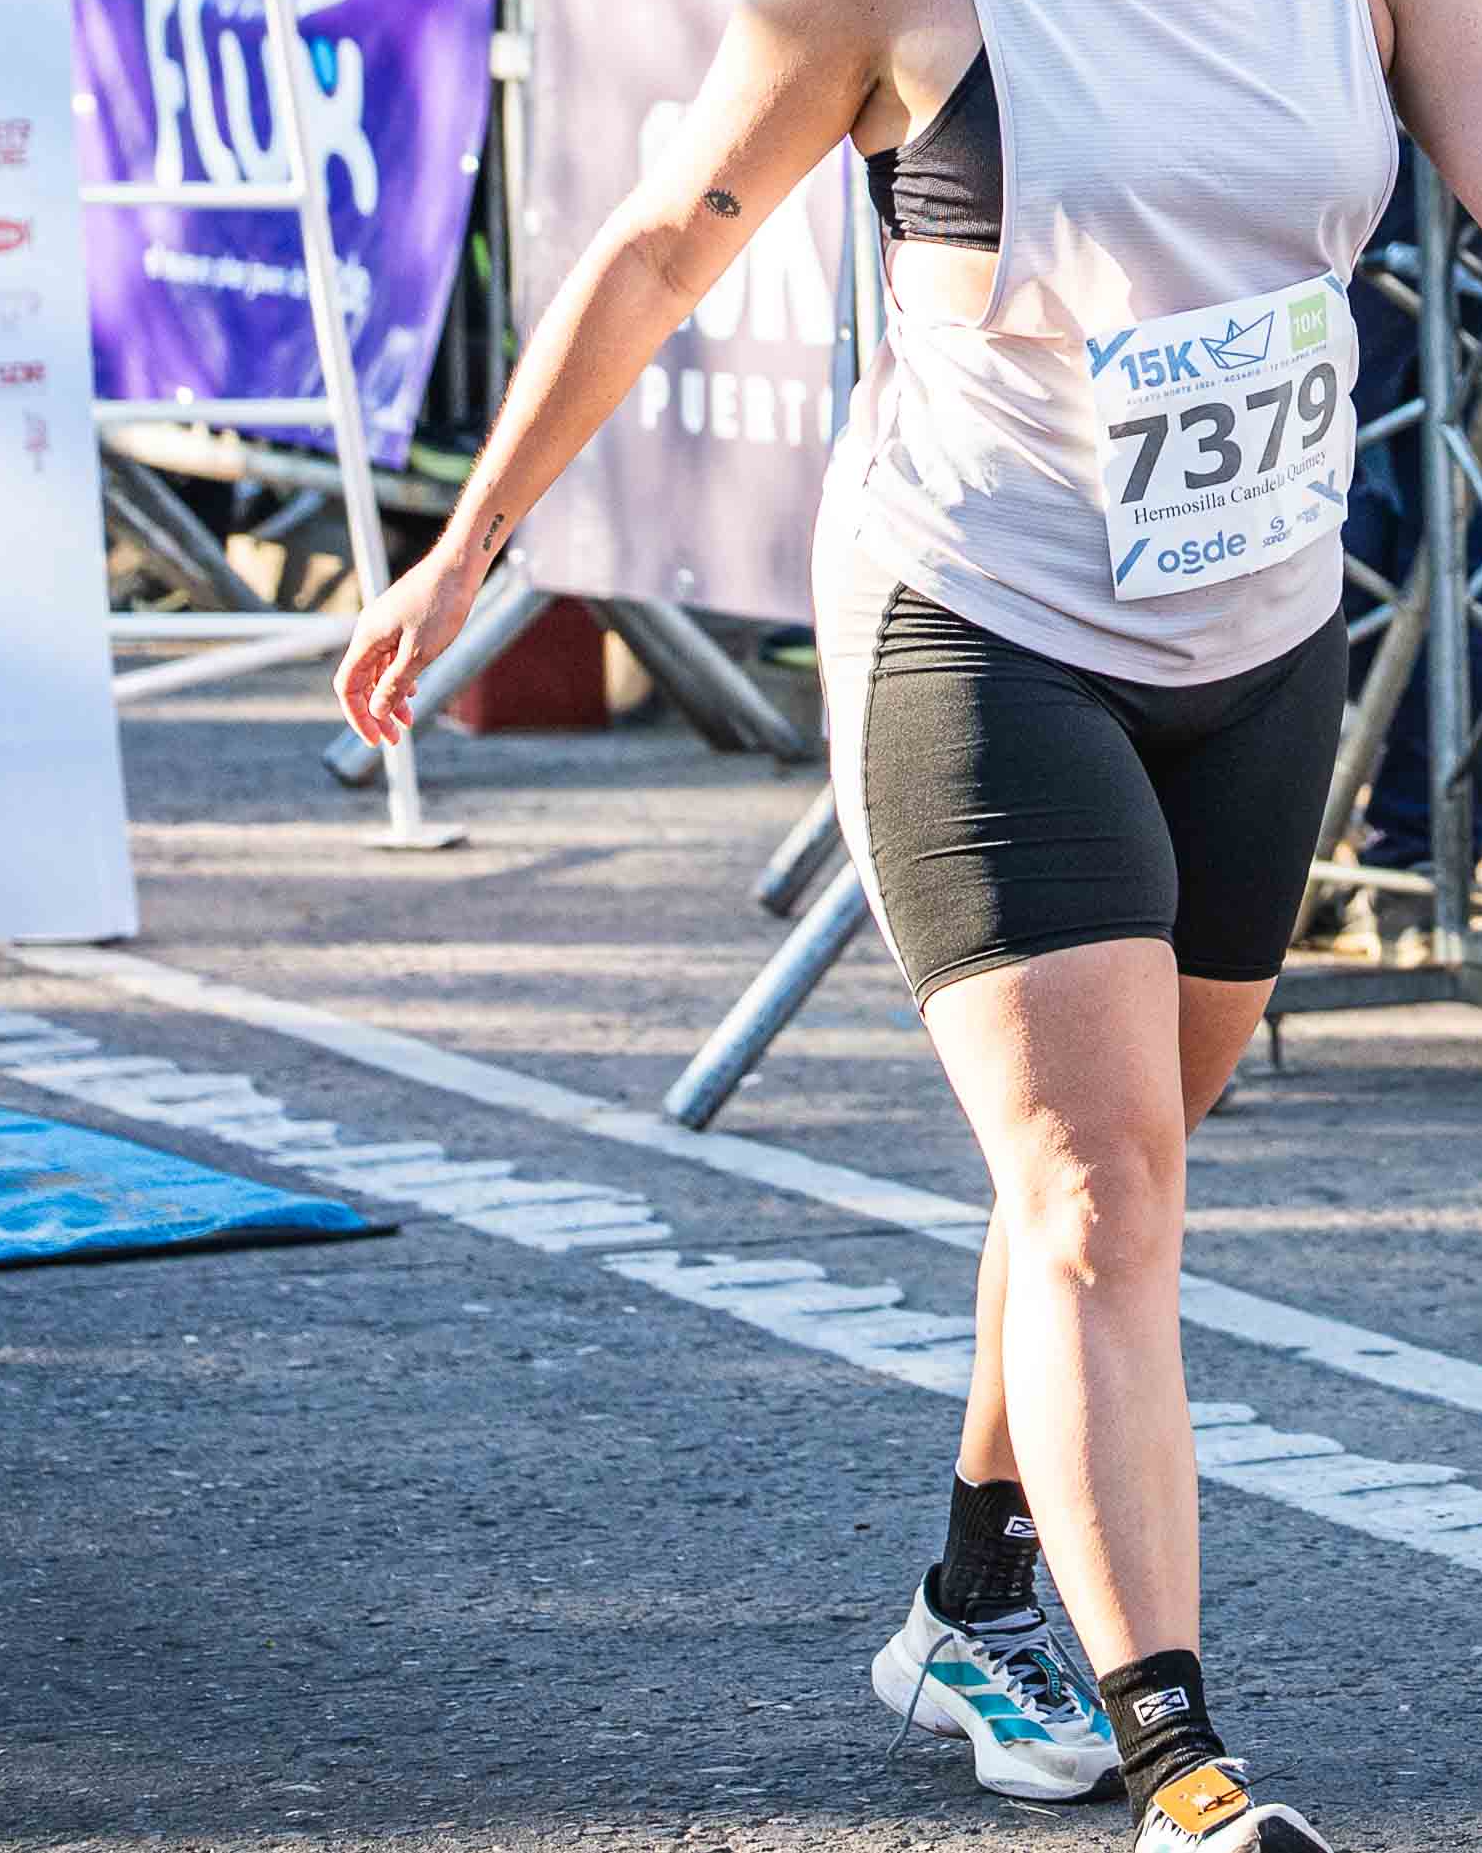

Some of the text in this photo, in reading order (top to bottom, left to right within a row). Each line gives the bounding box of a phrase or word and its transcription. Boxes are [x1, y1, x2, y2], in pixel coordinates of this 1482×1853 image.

[1120, 340, 1201, 390] 15K
[1108, 362, 1338, 505] 7379
[1134, 492, 1226, 524] Hermosilla
[1231, 474, 1285, 503] Candela
[1157, 530, 1247, 574] osde
